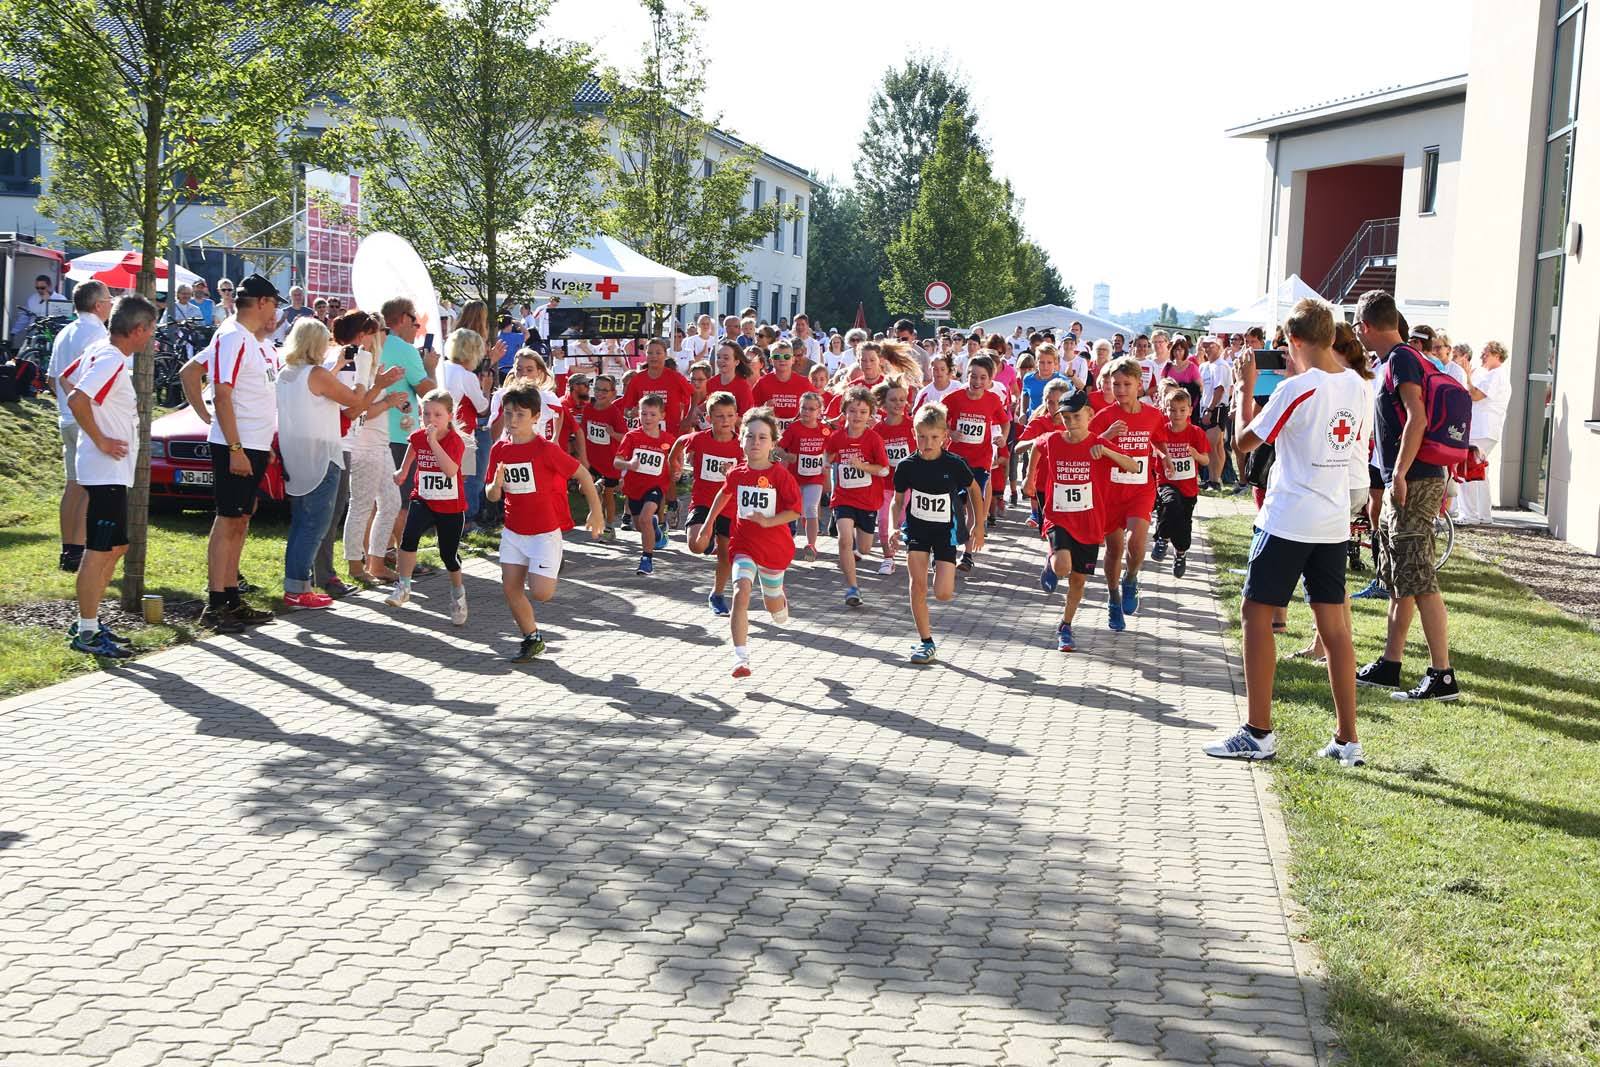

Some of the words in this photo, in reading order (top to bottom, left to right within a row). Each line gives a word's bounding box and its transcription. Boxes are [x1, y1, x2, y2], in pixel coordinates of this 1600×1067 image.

[589, 426, 605, 438] 813
[959, 422, 983, 436] 1929
[1118, 442, 1148, 450] HELFEN
[635, 452, 662, 468] 1849
[801, 457, 823, 468] 1964
[843, 467, 864, 480] 820
[423, 475, 453, 490] 1754
[741, 491, 769, 509] 845
[1065, 488, 1081, 502] 15
[916, 495, 946, 513] 1912
